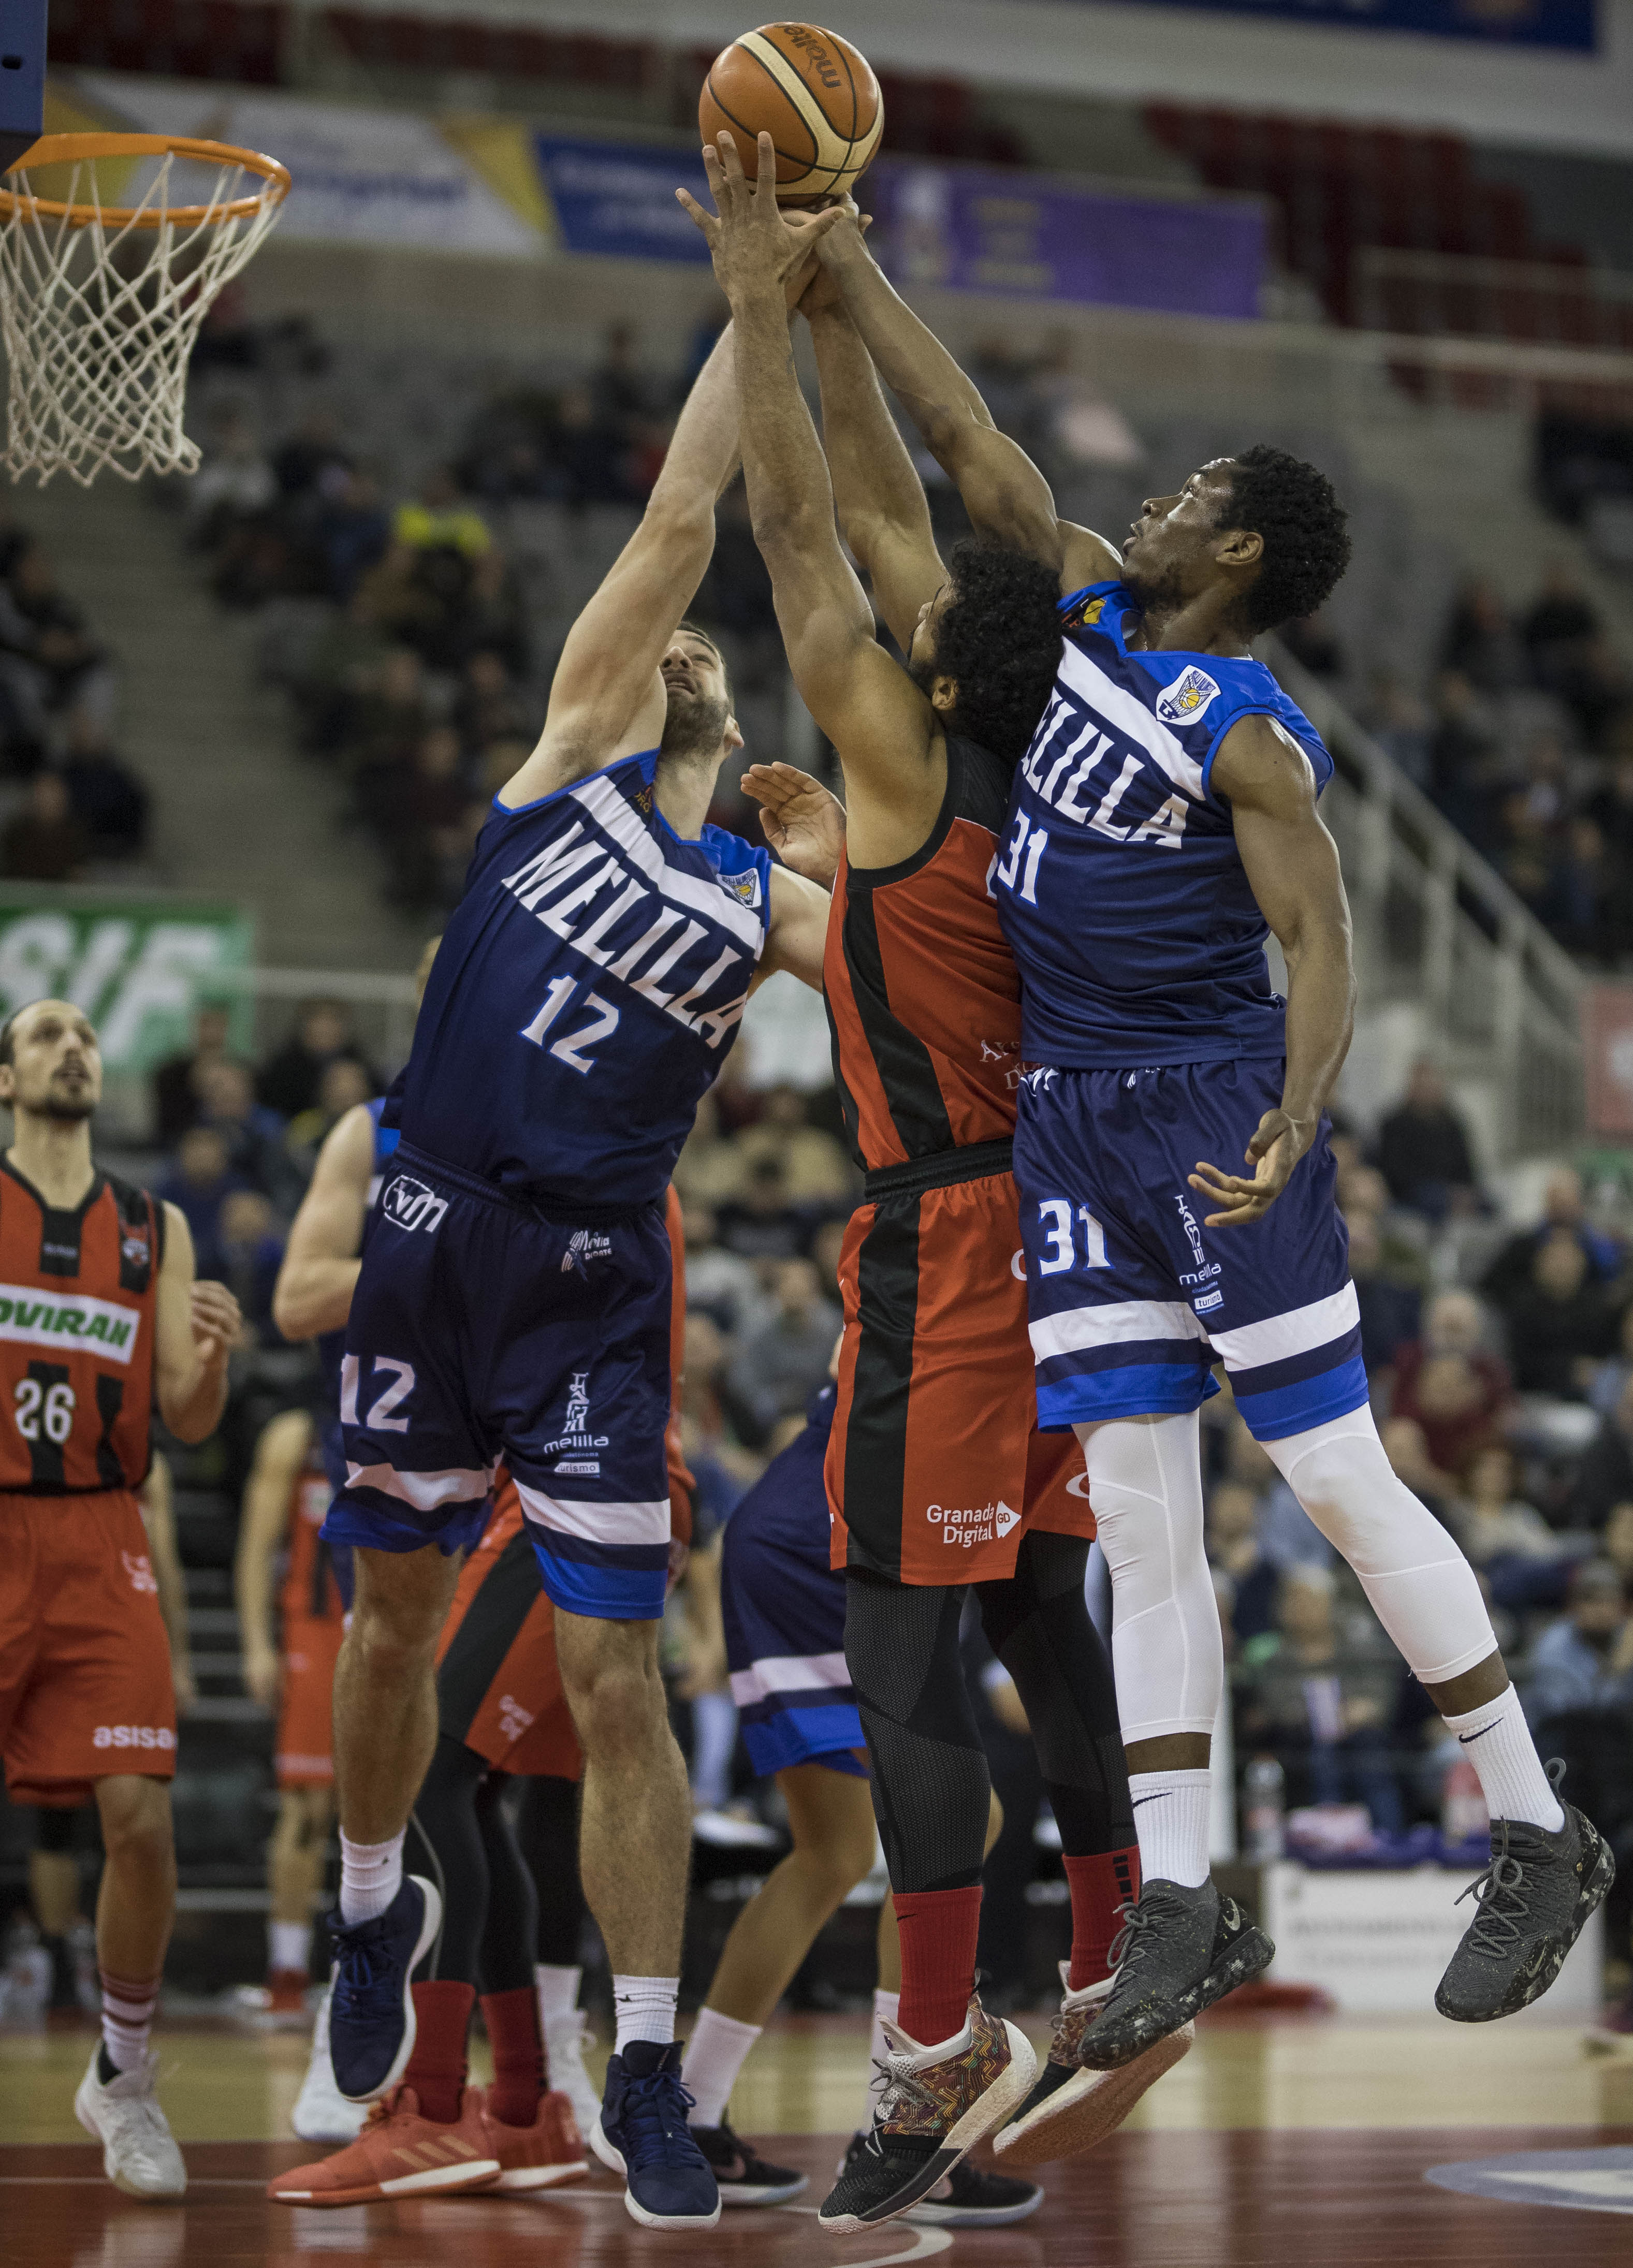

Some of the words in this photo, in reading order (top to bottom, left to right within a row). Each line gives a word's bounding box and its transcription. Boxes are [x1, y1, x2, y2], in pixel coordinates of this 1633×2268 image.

[777, 26, 841, 88] molte
[996, 804, 1049, 909] 31
[501, 820, 749, 1049] MELILLA
[518, 973, 621, 1077] 12
[1038, 1197, 1115, 1279] 31
[1198, 1294, 1220, 1307] turismo
[13, 1378, 76, 1444] 26
[339, 1351, 416, 1435] 12
[544, 1434, 609, 1454] melilla
[926, 1502, 995, 1524] Granada
[943, 1521, 993, 1548] Digital
[997, 1512, 1010, 1524] GD
[93, 1725, 177, 1749] asisa
